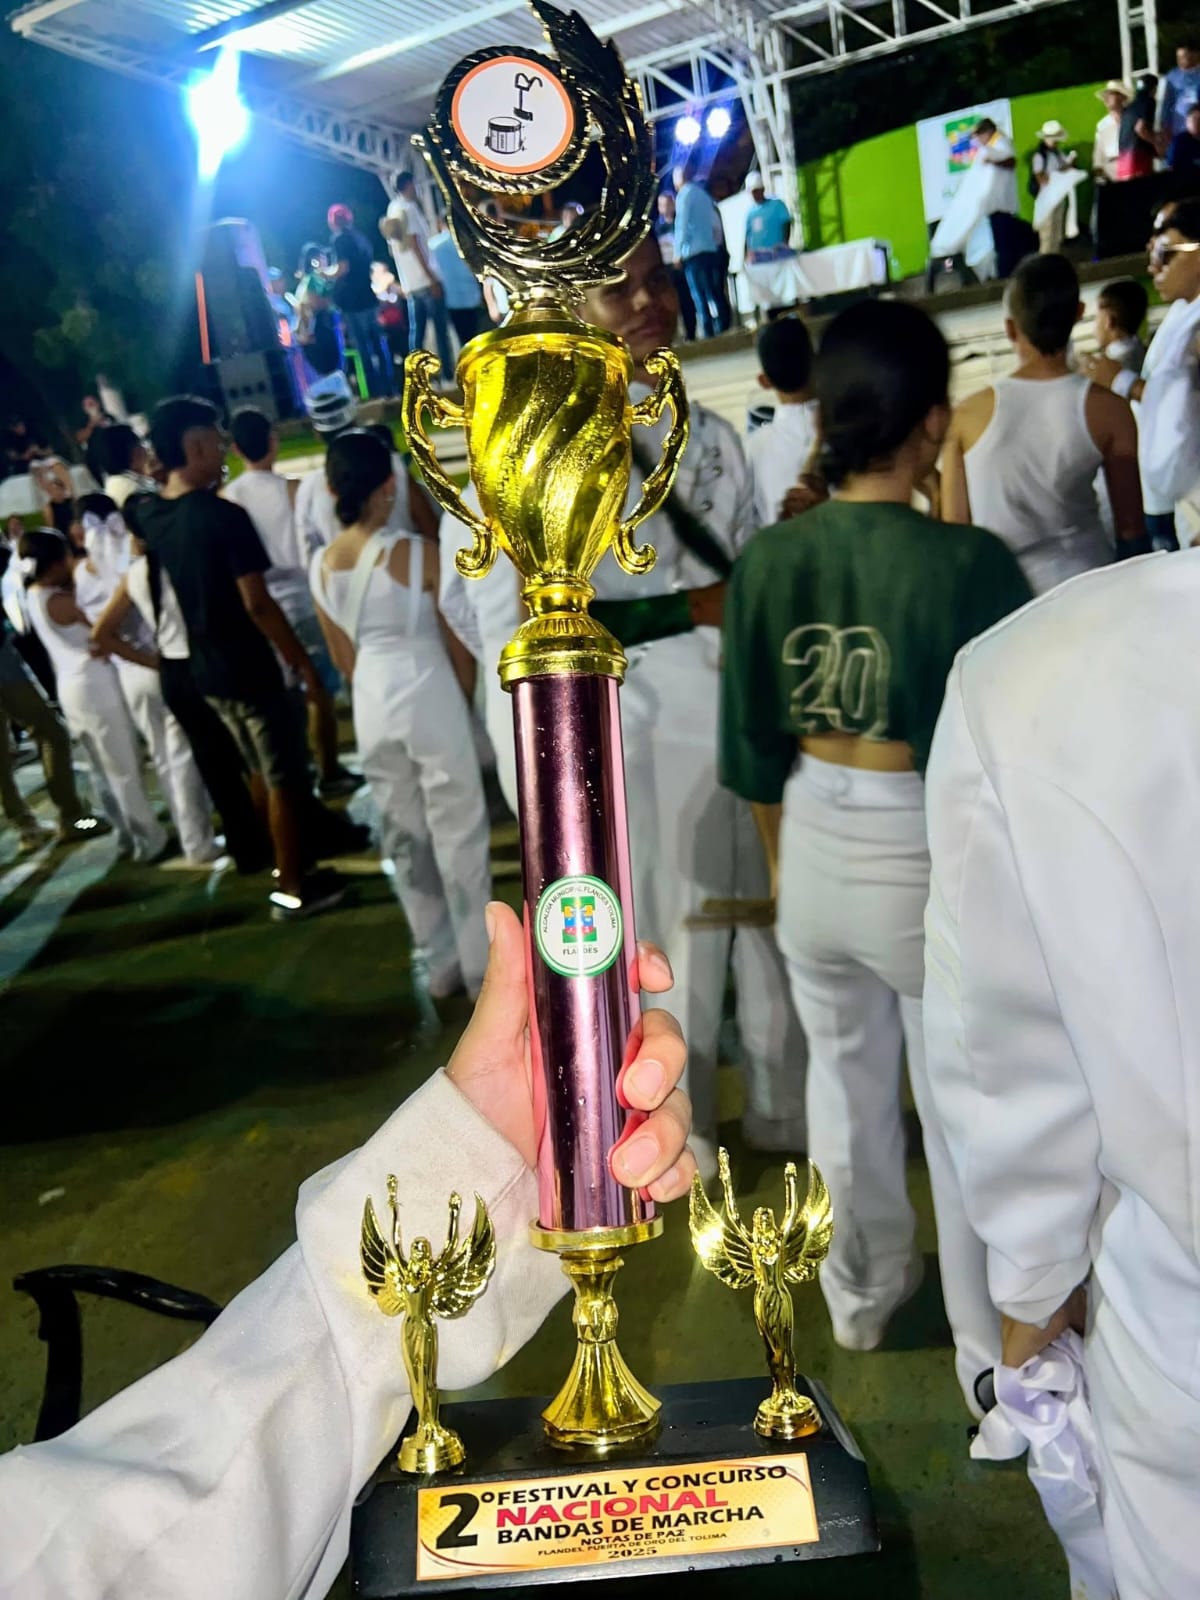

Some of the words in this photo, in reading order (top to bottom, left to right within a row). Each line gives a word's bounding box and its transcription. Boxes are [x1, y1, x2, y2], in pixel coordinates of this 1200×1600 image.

[782, 623, 891, 741] 20
[562, 947, 599, 956] FLADES
[498, 1482, 616, 1505] FESTIVAL
[623, 1479, 638, 1493] Y
[645, 1465, 787, 1490] CONCURSO
[496, 1489, 728, 1528] NACIONAL
[498, 1521, 603, 1544] BANDAS
[612, 1517, 644, 1533] DE
[652, 1506, 764, 1529] MARCHA
[581, 1534, 630, 1546] NOTAS
[634, 1532, 653, 1541] DE
[656, 1529, 685, 1539] PAZ
[587, 1543, 626, 1551] PUERTA
[690, 1533, 727, 1541] TOLIMA
[608, 1547, 657, 1559] 2025
